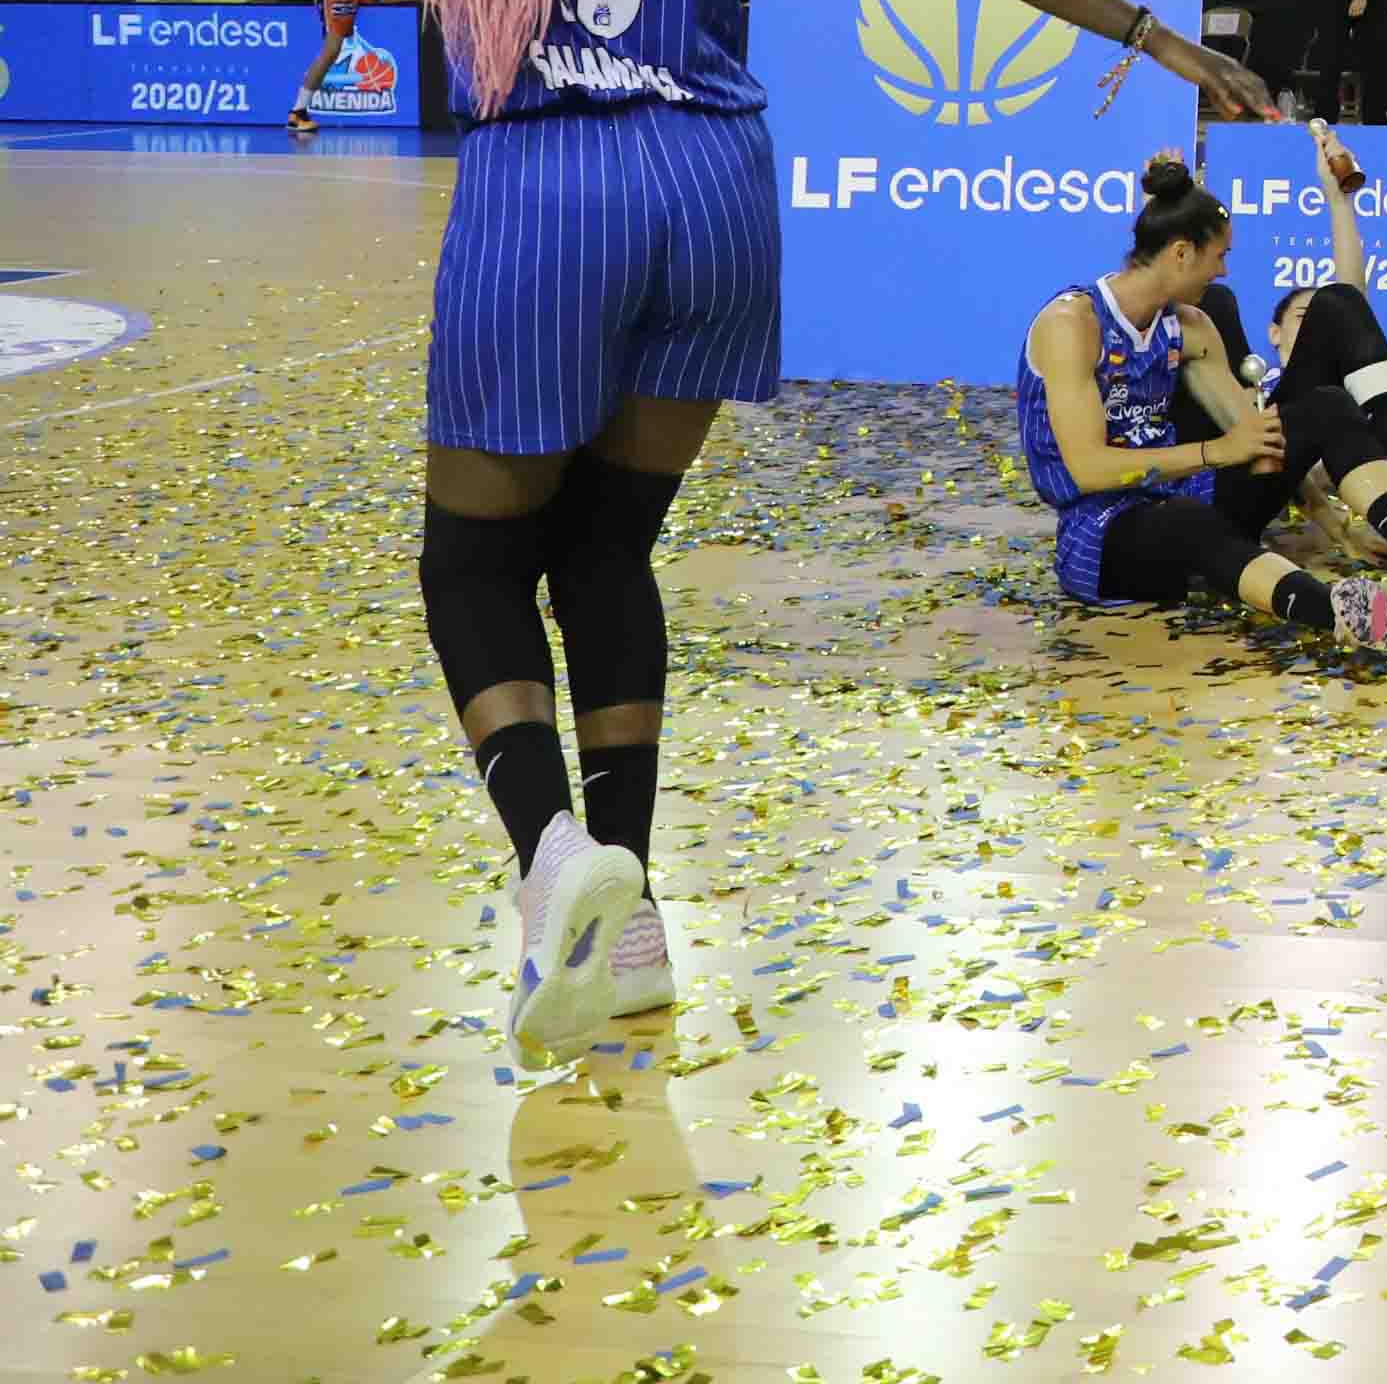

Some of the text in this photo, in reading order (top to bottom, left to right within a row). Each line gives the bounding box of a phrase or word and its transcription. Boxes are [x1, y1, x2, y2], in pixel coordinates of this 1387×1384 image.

[91, 11, 288, 47] LF endesa
[131, 82, 250, 113] 2020/21
[312, 89, 392, 111] AVENIDA
[791, 155, 1136, 213] LF endesa
[1231, 178, 1291, 215] LF
